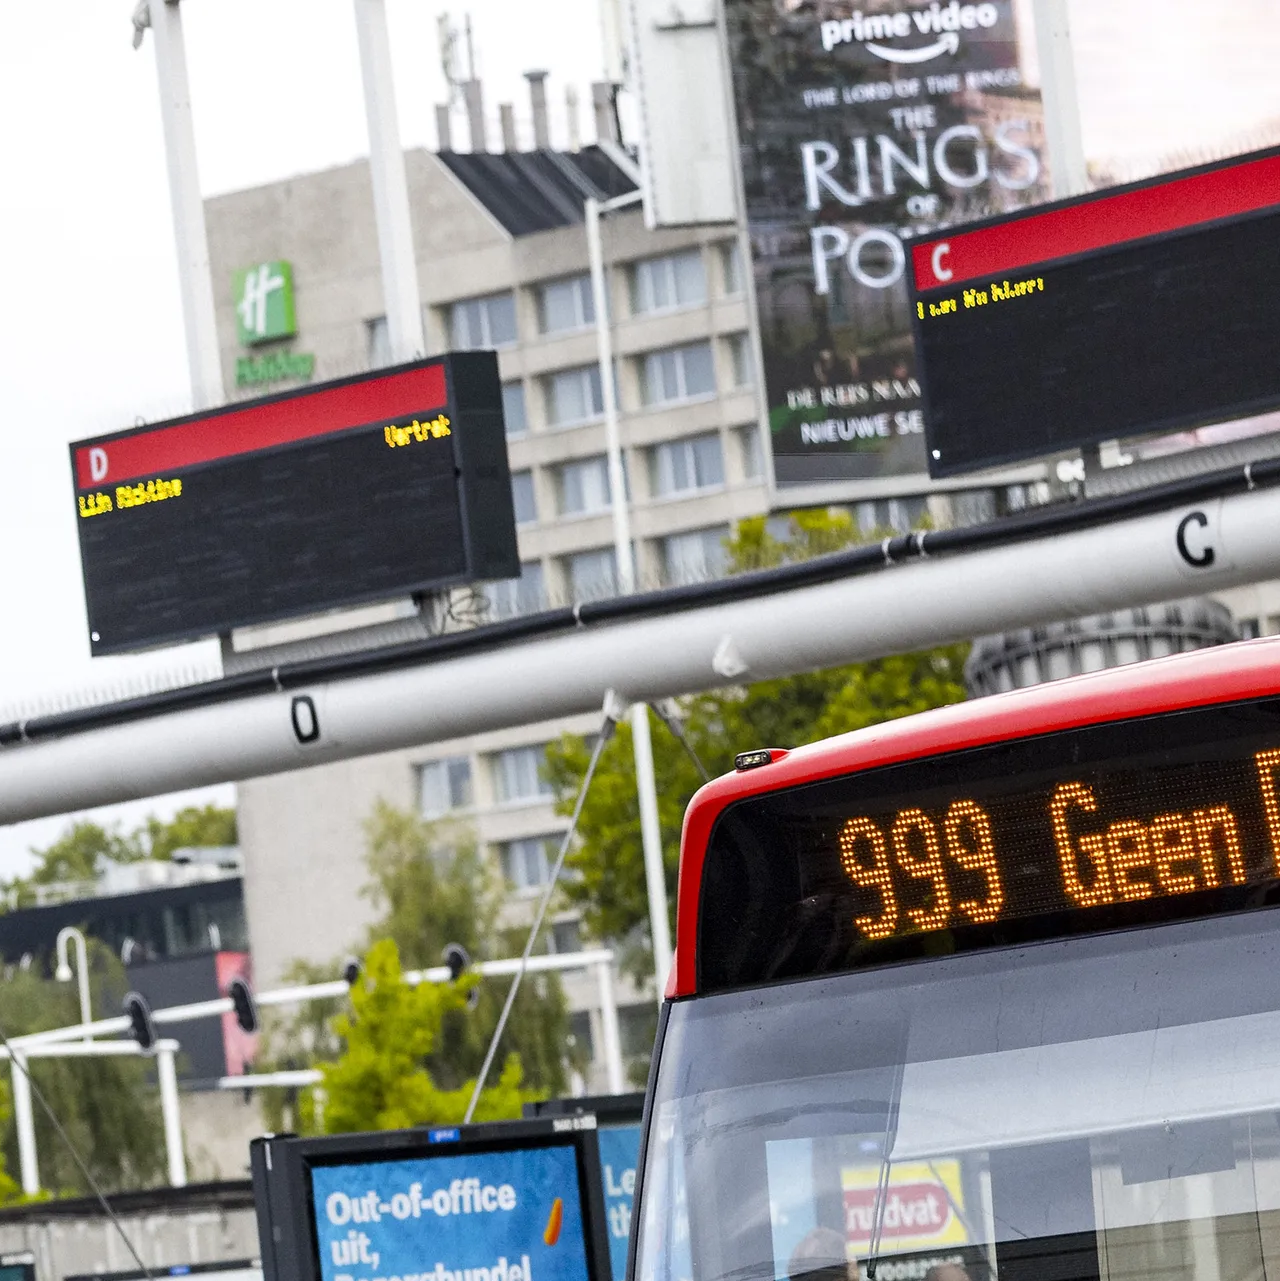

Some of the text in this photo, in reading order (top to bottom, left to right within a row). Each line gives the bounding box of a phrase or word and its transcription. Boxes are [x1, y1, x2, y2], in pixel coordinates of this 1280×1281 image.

[821, 1, 998, 51] prime video
[803, 87, 838, 109] THE
[842, 81, 893, 104] LORD
[892, 77, 920, 98] OF
[926, 73, 960, 95] THE
[888, 104, 938, 130] THE
[801, 119, 1040, 211] RINGS
[906, 194, 940, 217] OF
[931, 243, 954, 281] C
[800, 412, 890, 445] NIEUWE
[89, 447, 108, 481] D
[1176, 511, 1215, 567] C
[837, 799, 1004, 940] 999
[1050, 781, 1245, 908] Geen
[604, 1164, 636, 1196] Le
[326, 1177, 517, 1226] Out-of-office
[331, 1229, 380, 1271] uit,
